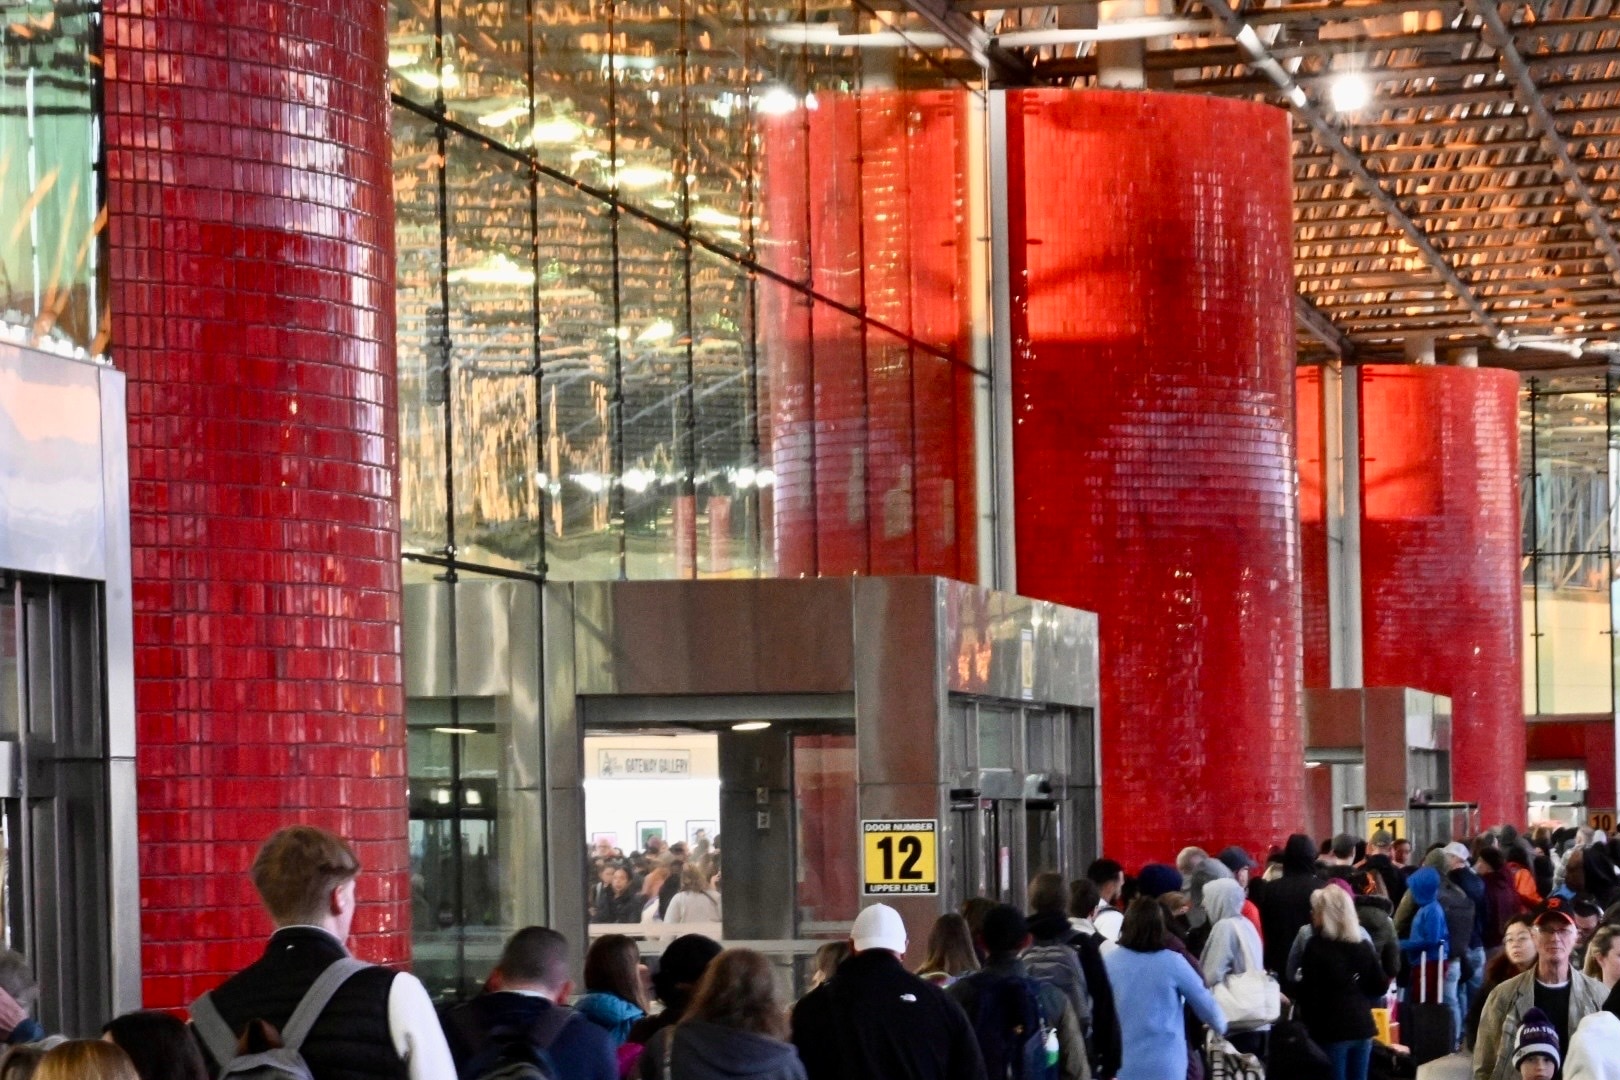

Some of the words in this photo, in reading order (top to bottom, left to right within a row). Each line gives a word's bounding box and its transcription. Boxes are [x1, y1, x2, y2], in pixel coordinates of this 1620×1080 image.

[865, 823, 891, 831] DOOR
[893, 823, 934, 831] NUMBER
[876, 835, 923, 880] 12
[869, 884, 900, 892] UPPER
[902, 884, 931, 892] LEVEL
